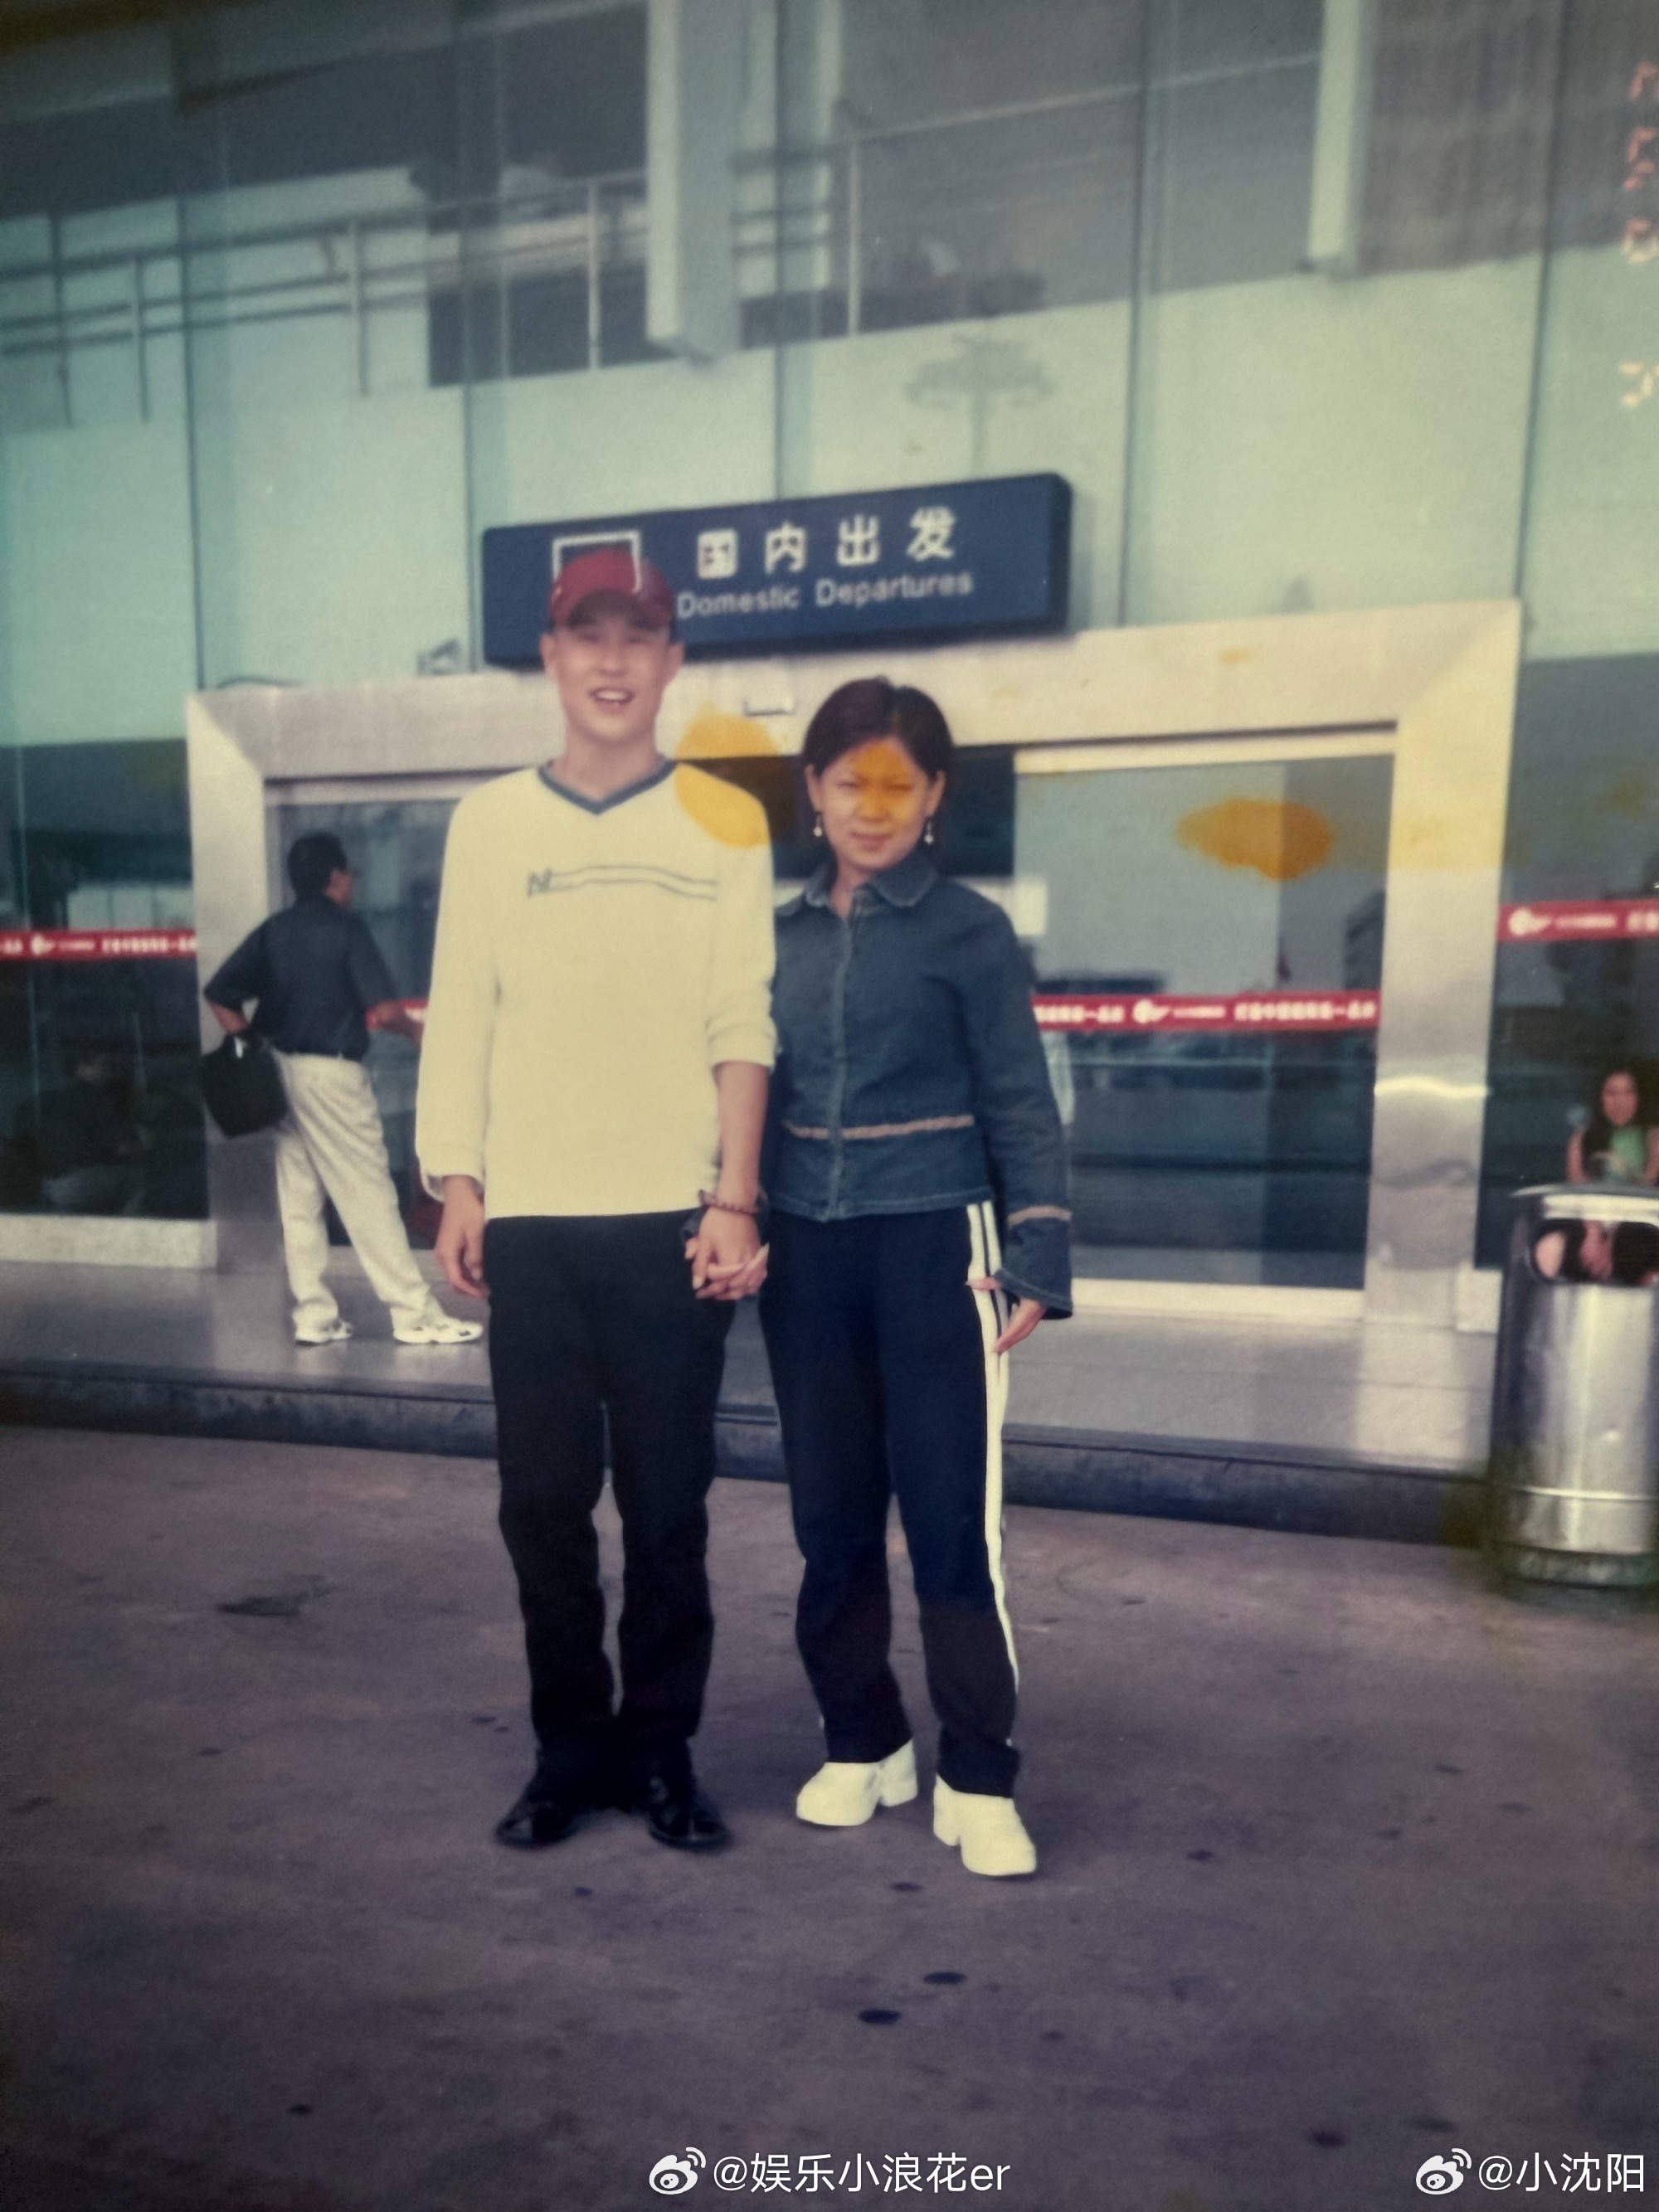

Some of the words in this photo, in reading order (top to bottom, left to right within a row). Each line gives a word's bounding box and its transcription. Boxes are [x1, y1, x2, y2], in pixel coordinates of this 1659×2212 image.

[696, 506, 956, 579] 国内出发
[676, 586, 800, 620] Domestic
[815, 571, 974, 609] Departures
